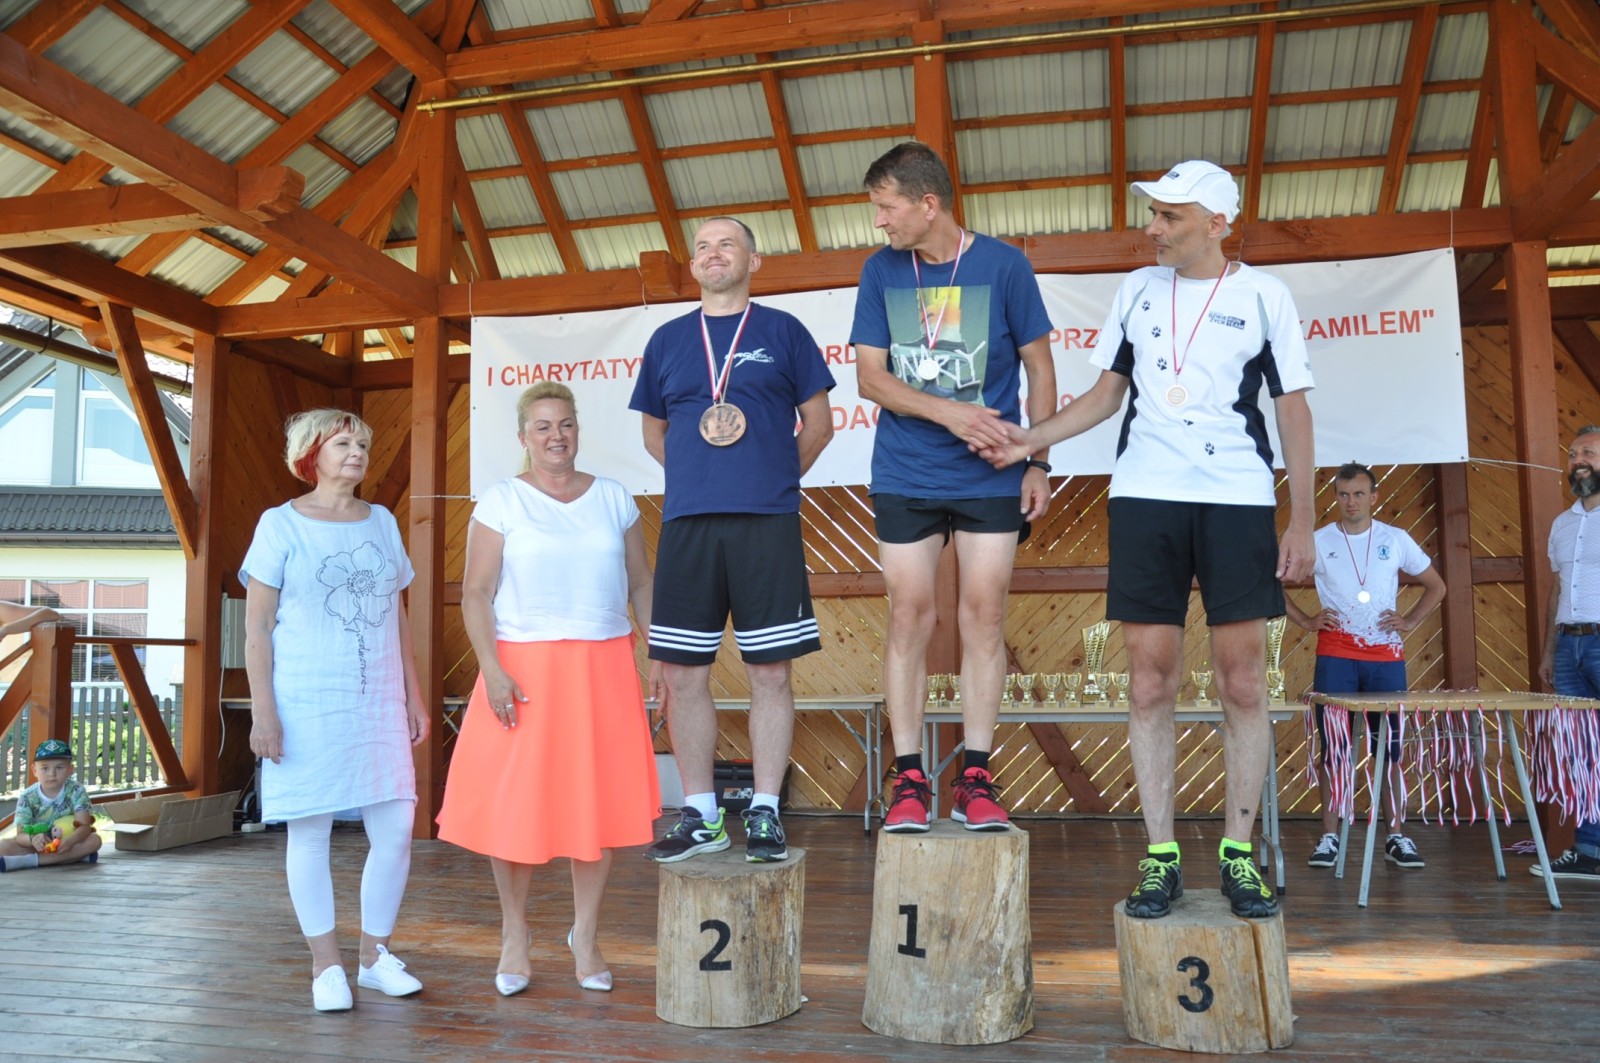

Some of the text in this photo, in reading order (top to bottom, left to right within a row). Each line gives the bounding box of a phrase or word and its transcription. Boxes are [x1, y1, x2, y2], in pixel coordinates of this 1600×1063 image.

[487, 309, 1434, 387] I CHARYTATY RD PRZ AMILEM"
[699, 919, 732, 971] 2
[898, 904, 926, 959] 1
[1177, 956, 1213, 1013] 3
